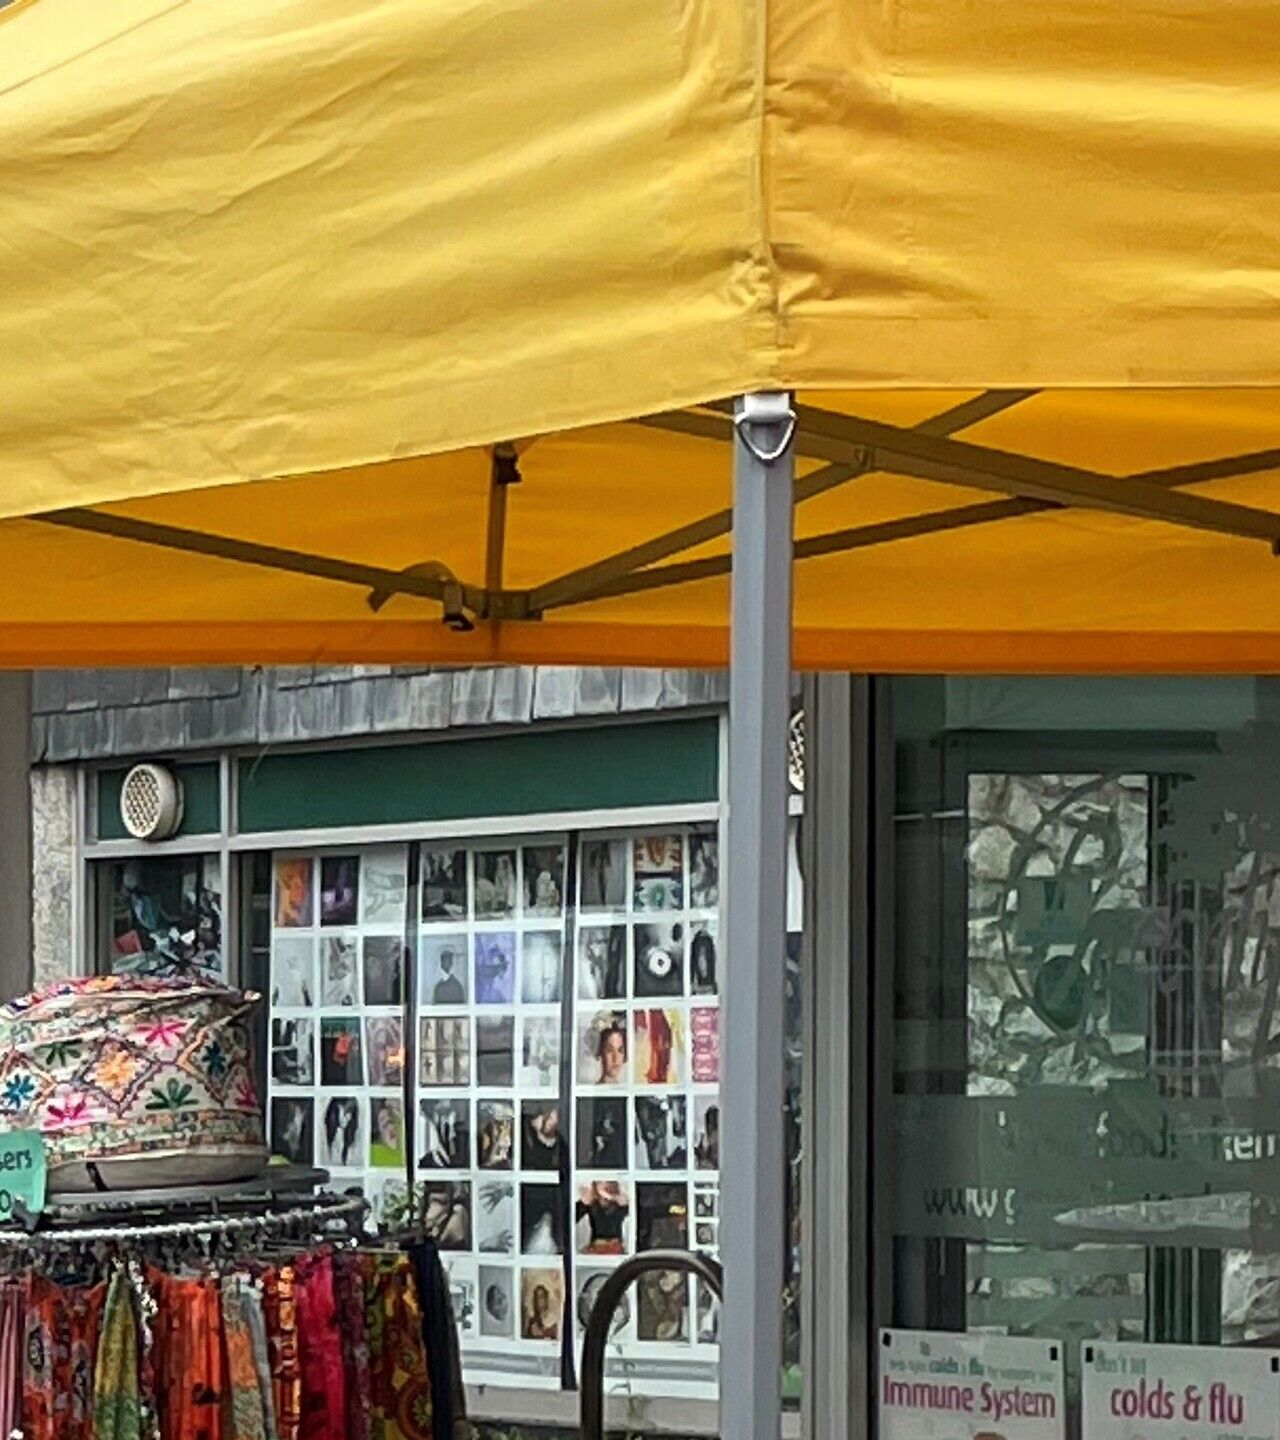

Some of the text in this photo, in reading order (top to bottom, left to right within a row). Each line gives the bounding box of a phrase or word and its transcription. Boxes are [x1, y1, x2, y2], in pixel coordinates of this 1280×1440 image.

[883, 1375, 1056, 1422] Immune System
[1110, 1377, 1244, 1425] colds & flu
